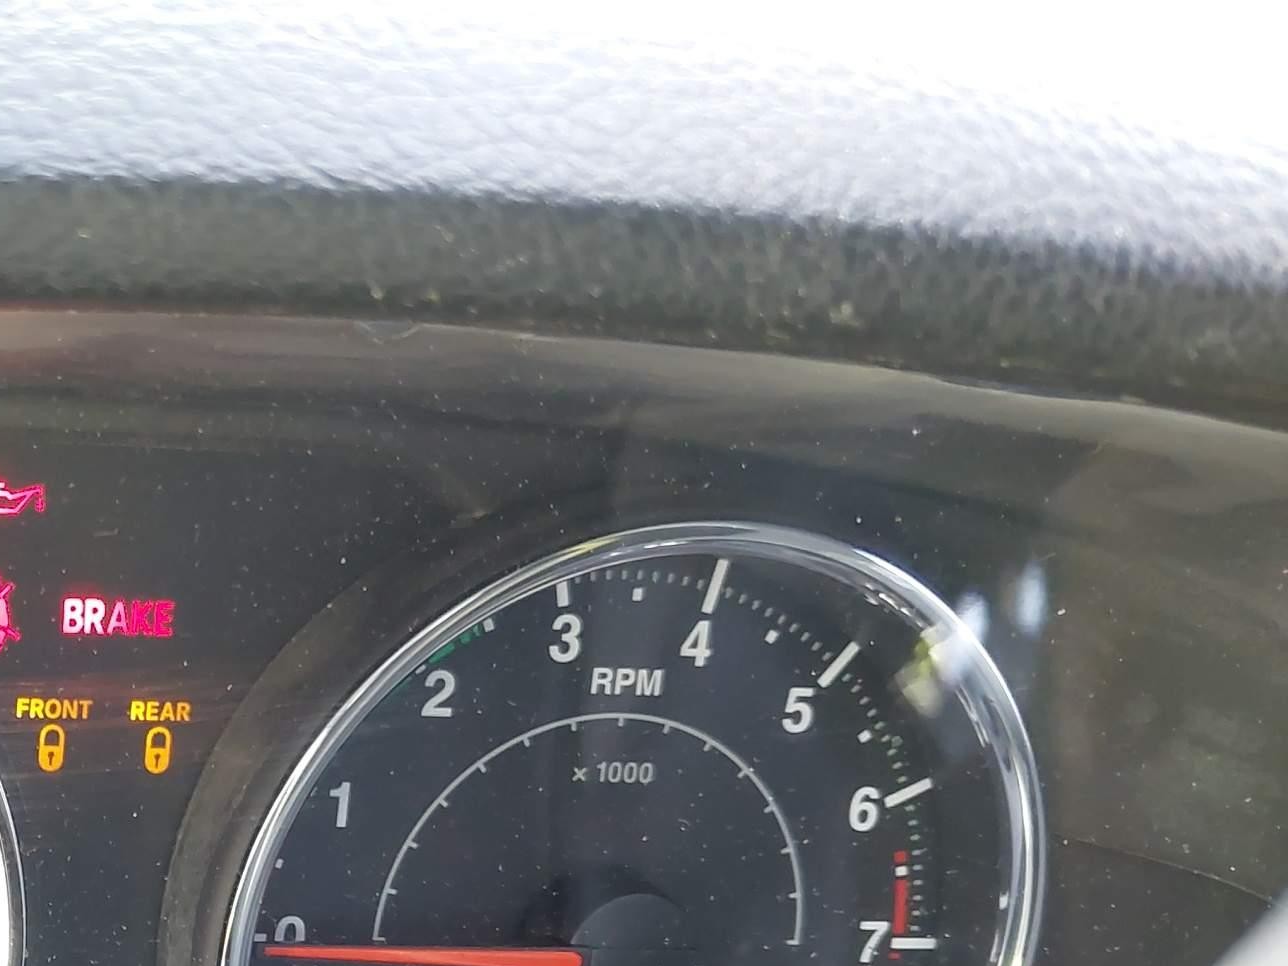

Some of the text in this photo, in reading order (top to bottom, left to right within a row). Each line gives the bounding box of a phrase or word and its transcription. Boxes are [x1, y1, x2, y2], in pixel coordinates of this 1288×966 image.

[62, 597, 175, 637] BRAKE
[549, 615, 581, 664] 3
[680, 619, 713, 666] 4
[421, 670, 456, 718] 2
[589, 667, 664, 697] RPM
[15, 697, 93, 720] FRONT
[129, 700, 191, 722] REAR
[782, 689, 816, 735] 5
[595, 761, 655, 785] 1000
[330, 781, 352, 828] 1
[849, 786, 879, 832] 6
[859, 920, 890, 964] 7
